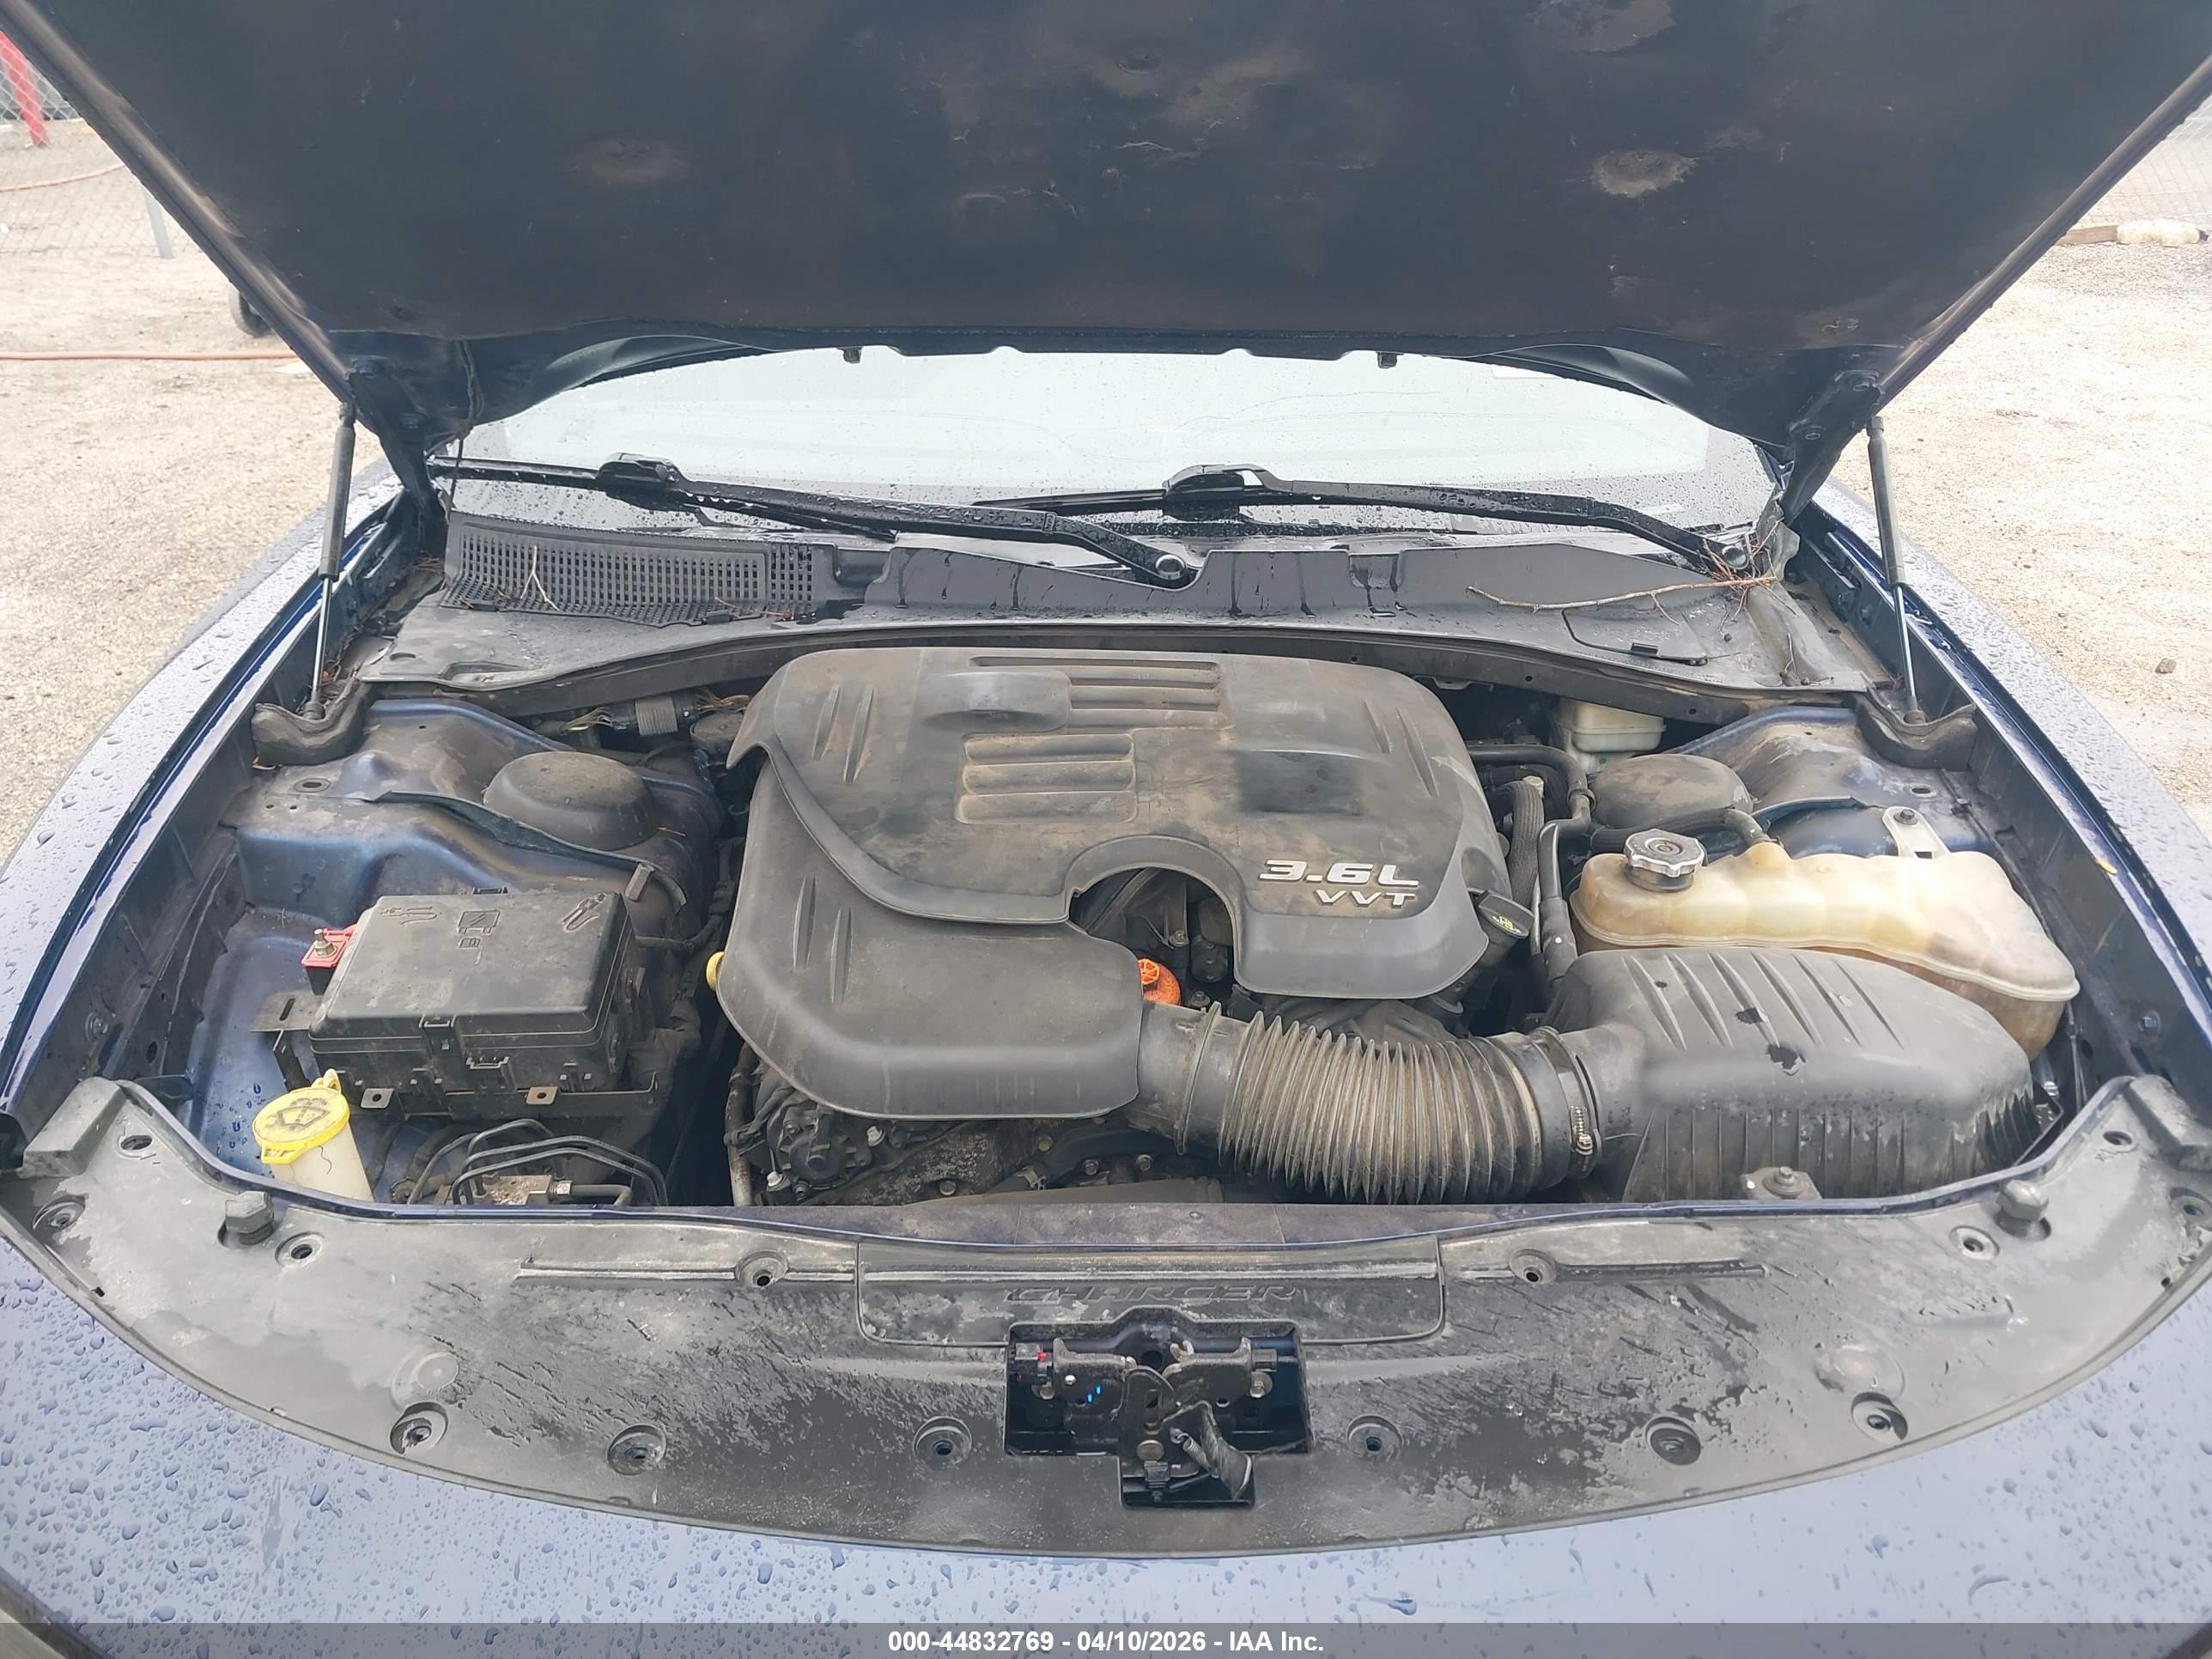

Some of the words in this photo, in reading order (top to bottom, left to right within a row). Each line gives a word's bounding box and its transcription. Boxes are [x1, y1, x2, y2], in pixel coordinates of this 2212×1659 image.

[1258, 860, 1419, 887] 3.6L
[1316, 890, 1416, 907] VVT
[1004, 1285, 1299, 1304] CHARGER
